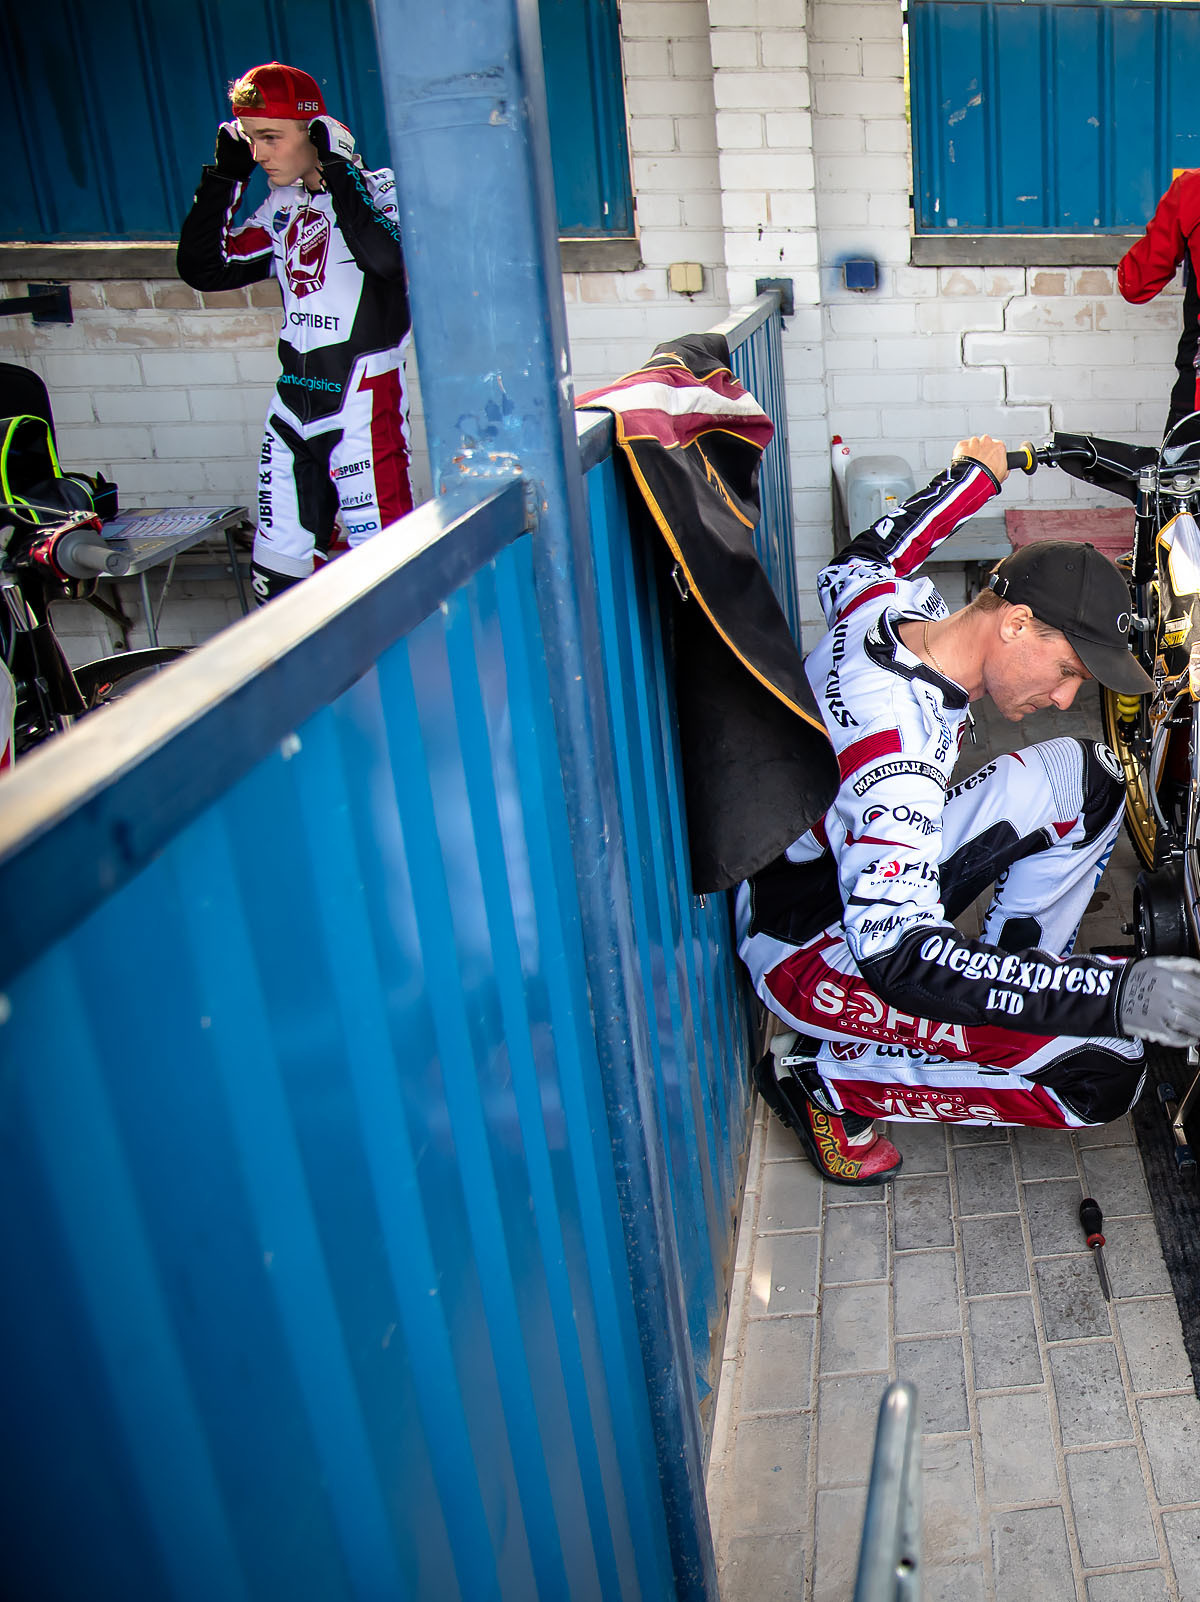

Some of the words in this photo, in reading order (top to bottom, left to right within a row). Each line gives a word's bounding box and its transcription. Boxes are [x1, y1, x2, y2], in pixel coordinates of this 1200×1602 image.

[290, 312, 340, 331] OPTIBET
[260, 470, 272, 485] &
[259, 490, 273, 528] JBM
[854, 761, 921, 796] MALINIAK
[920, 935, 1114, 996] OlegsExpress
[985, 988, 1024, 1015] LTD
[840, 1020, 935, 1050] DAUGAVPILS
